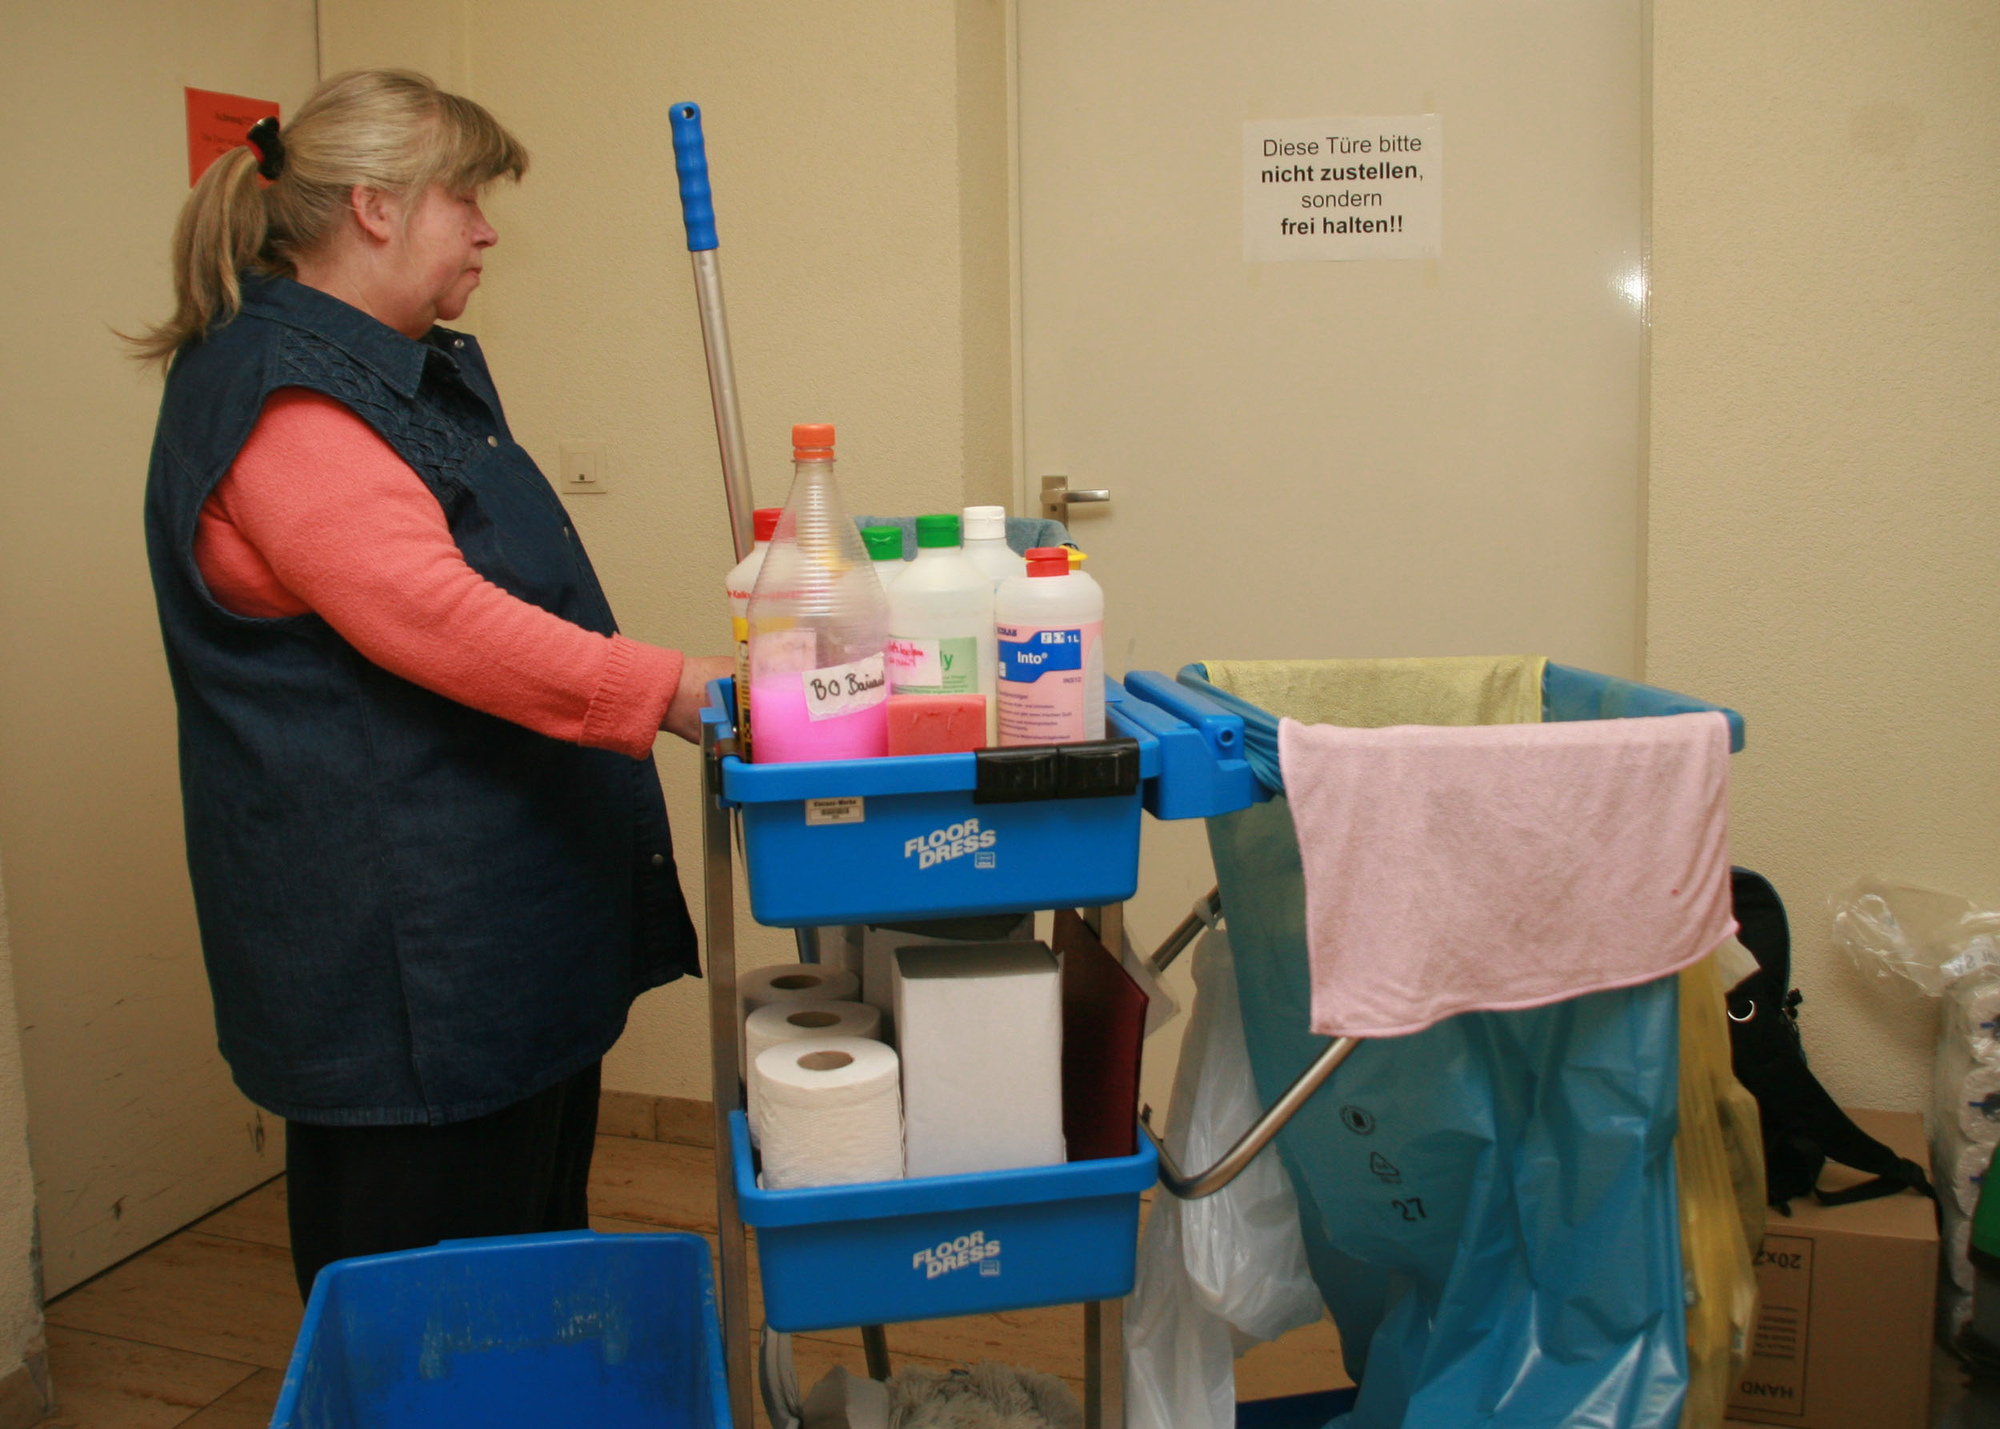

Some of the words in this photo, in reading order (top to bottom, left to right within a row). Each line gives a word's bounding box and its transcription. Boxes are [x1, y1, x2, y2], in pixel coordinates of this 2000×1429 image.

[1263, 138, 1319, 157] Diese
[1326, 136, 1372, 154] Türe
[1379, 134, 1422, 152] bitte
[1261, 165, 1314, 183] nicht
[1320, 161, 1424, 182] zustellen,
[1301, 190, 1382, 208] sondern
[1281, 217, 1315, 235] frei
[1322, 215, 1403, 234] halten!!
[904, 818, 979, 858] FLOOR
[919, 829, 997, 870] DRESS
[1391, 1196, 1427, 1221] 27
[912, 1230, 984, 1270] FLOOR
[926, 1239, 1001, 1280] DRESS
[1741, 1380, 1794, 1399] HAND
